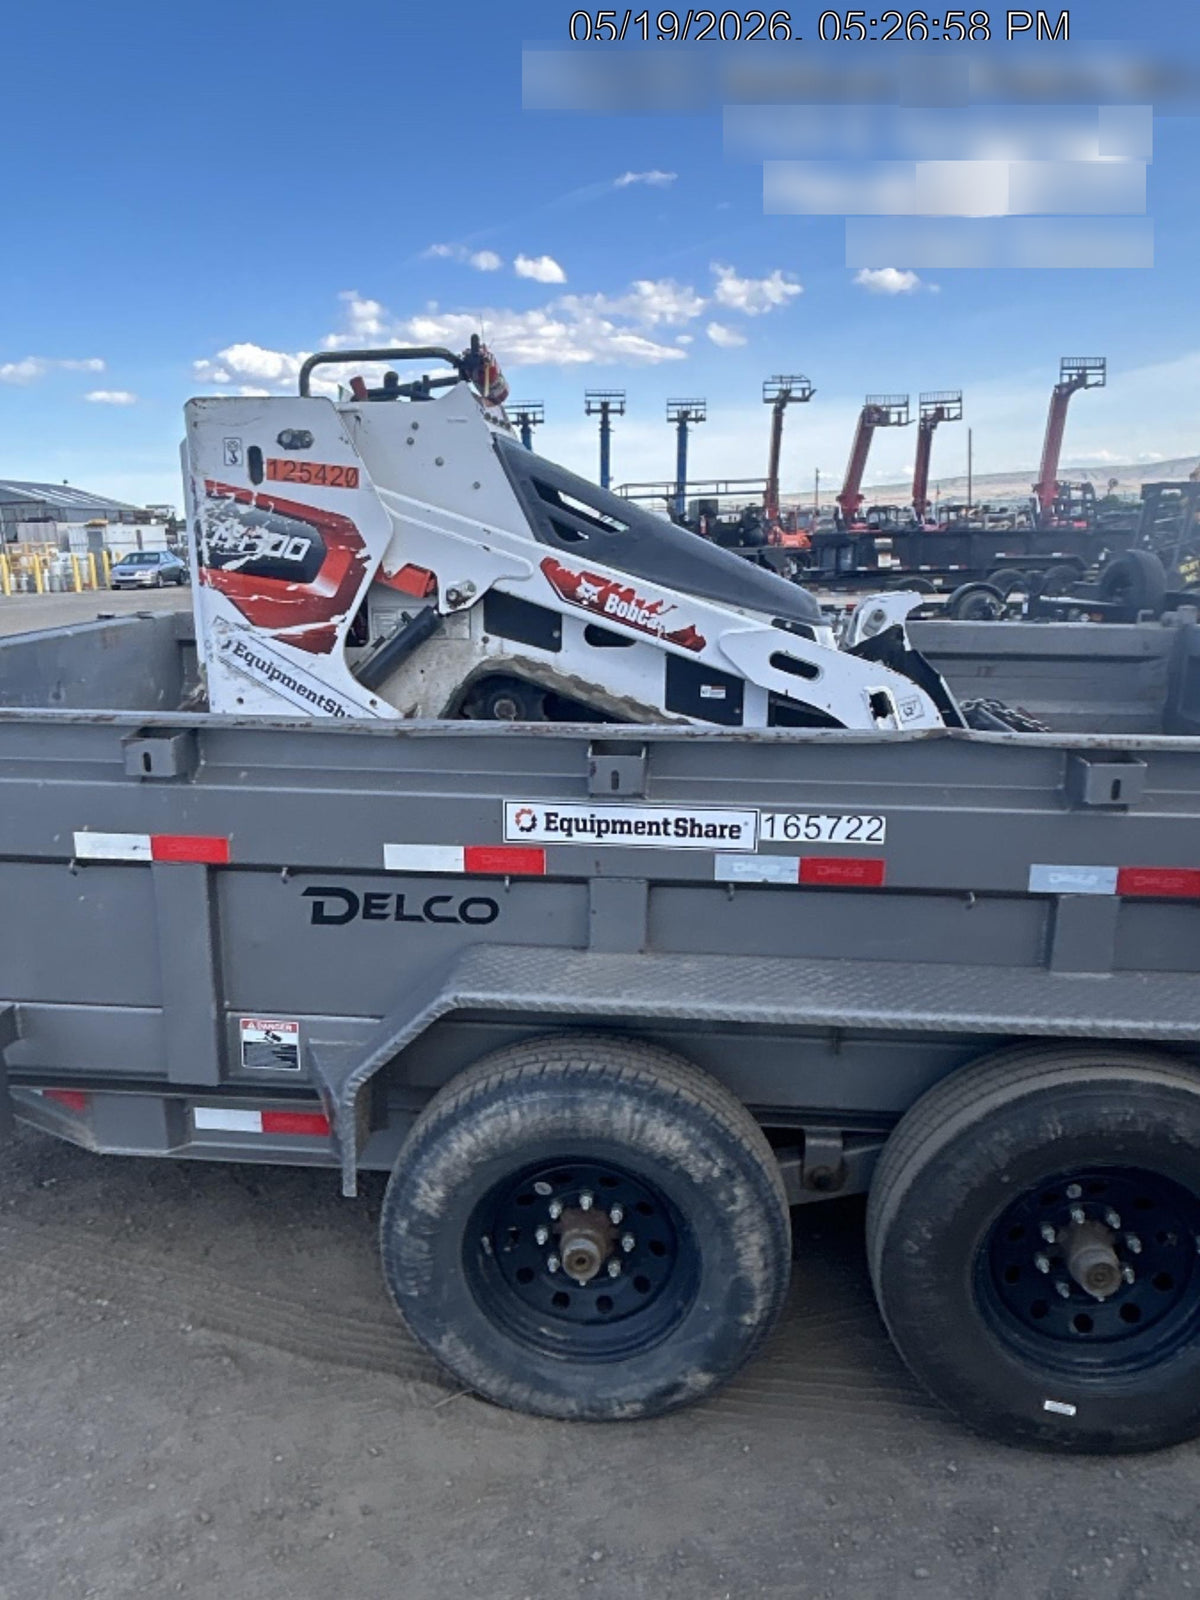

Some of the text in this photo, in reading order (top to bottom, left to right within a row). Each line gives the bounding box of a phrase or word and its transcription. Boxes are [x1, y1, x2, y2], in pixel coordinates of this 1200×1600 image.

[267, 460, 359, 488] 125420
[604, 593, 665, 636] Bobca
[543, 811, 742, 840] EquipmentShare
[764, 814, 883, 842] 165722
[301, 886, 499, 925] DELCO
